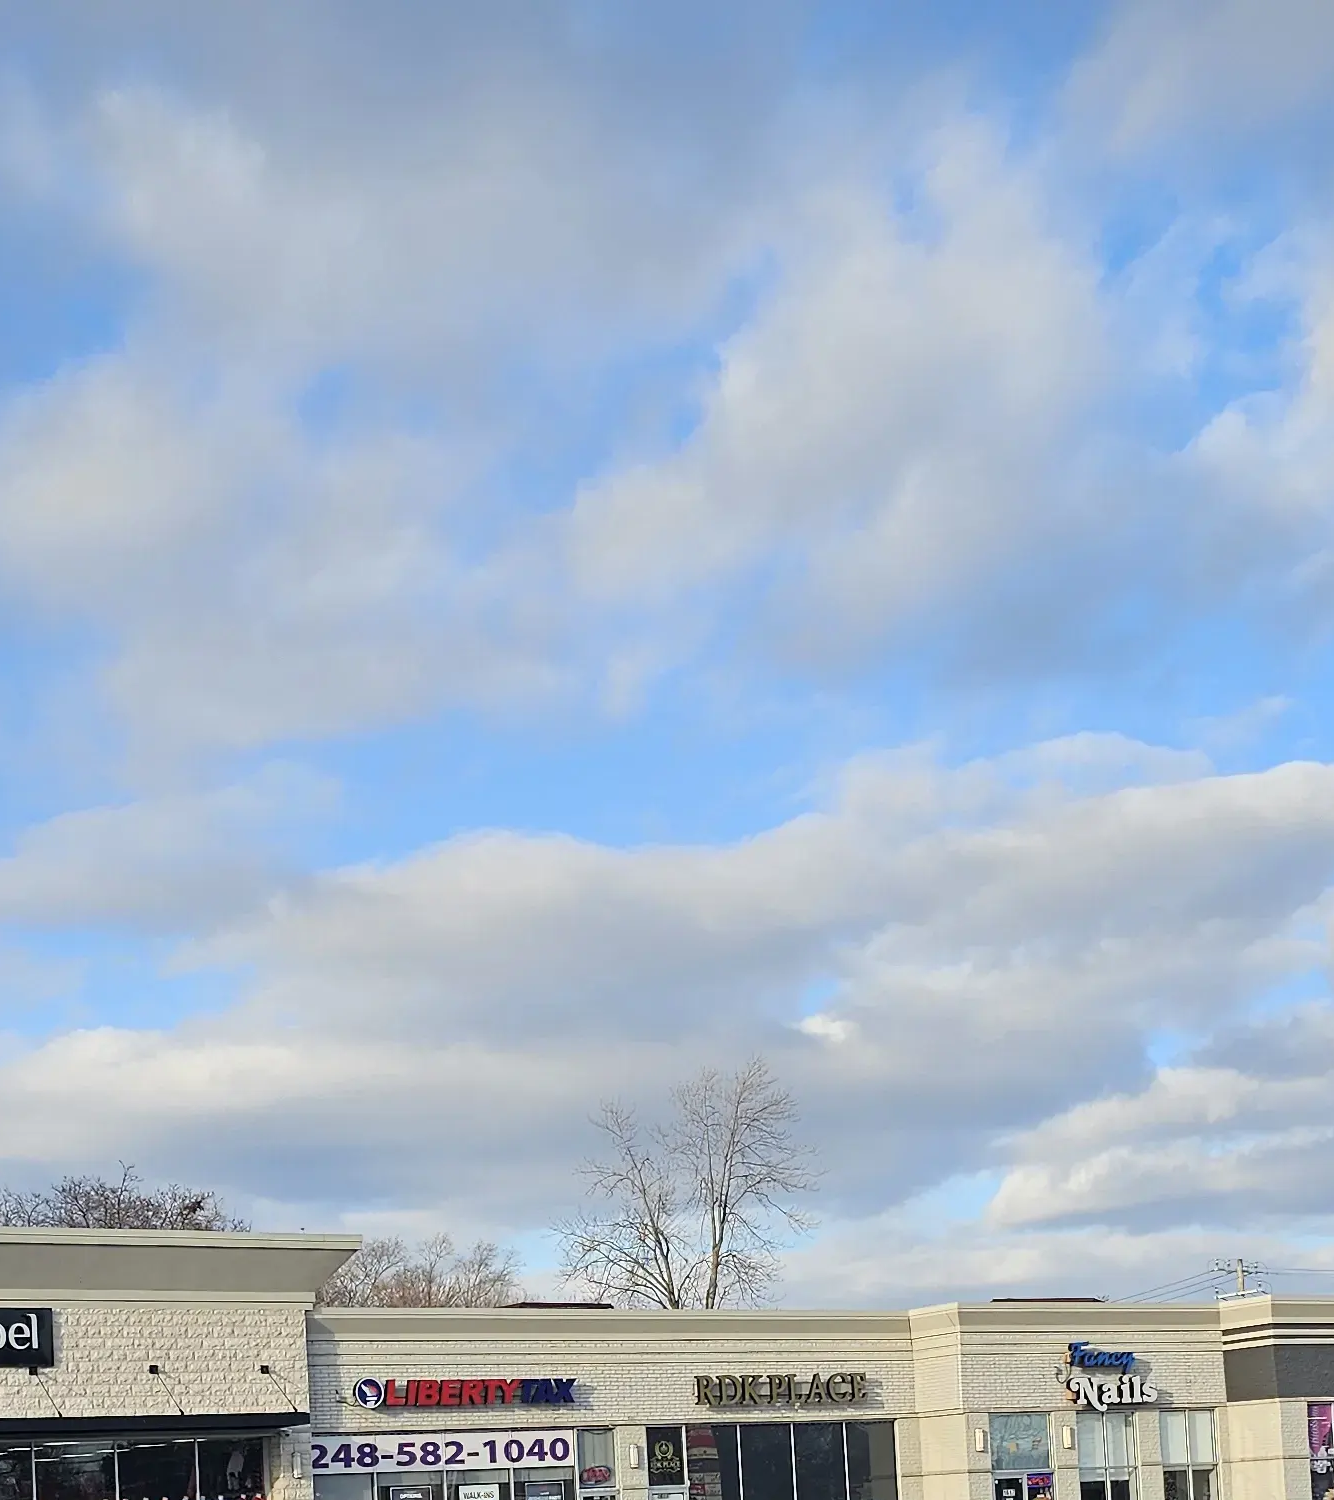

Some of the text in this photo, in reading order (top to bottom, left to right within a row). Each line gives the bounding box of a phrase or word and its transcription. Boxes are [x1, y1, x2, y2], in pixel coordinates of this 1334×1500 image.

[1068, 1341, 1136, 1374] Fancy
[694, 1372, 867, 1406] RDK PLACE
[1069, 1374, 1159, 1412] Nails
[311, 1436, 570, 1470] 248-582-1040
[463, 1490, 495, 1500] WALK-INS
